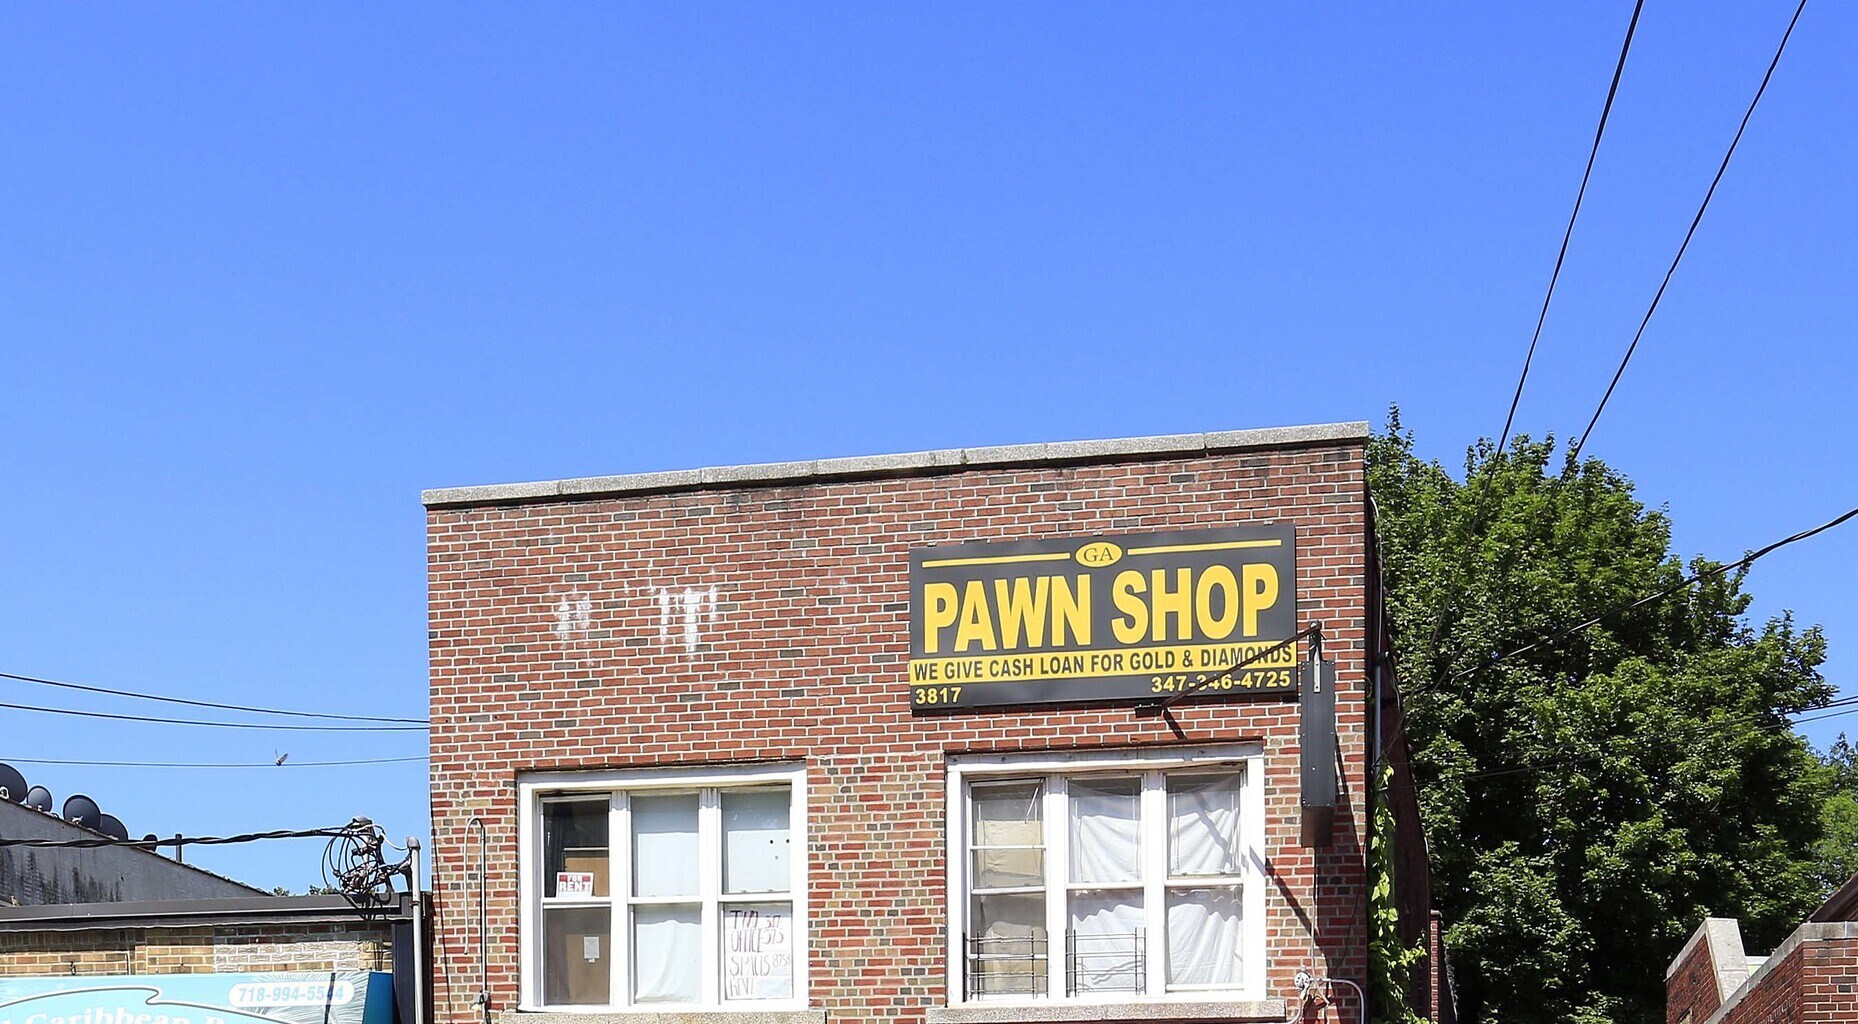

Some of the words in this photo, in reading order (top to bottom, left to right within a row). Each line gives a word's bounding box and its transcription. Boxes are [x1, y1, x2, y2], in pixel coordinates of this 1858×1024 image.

[1083, 547, 1114, 563] GA
[924, 574, 1091, 654] PAWN
[1112, 563, 1279, 644] SHOP
[914, 662, 938, 681] WE
[945, 660, 985, 680] GIVE
[989, 657, 1034, 677] CASH
[1040, 655, 1084, 675] LOAN
[1091, 653, 1124, 672] FOR
[1130, 650, 1175, 670] GOLD
[1182, 649, 1194, 667] &
[1201, 645, 1292, 667] DIAMONDS
[915, 687, 962, 706] 3817
[559, 882, 590, 892] RENT
[238, 985, 344, 1002] 718-994-554
